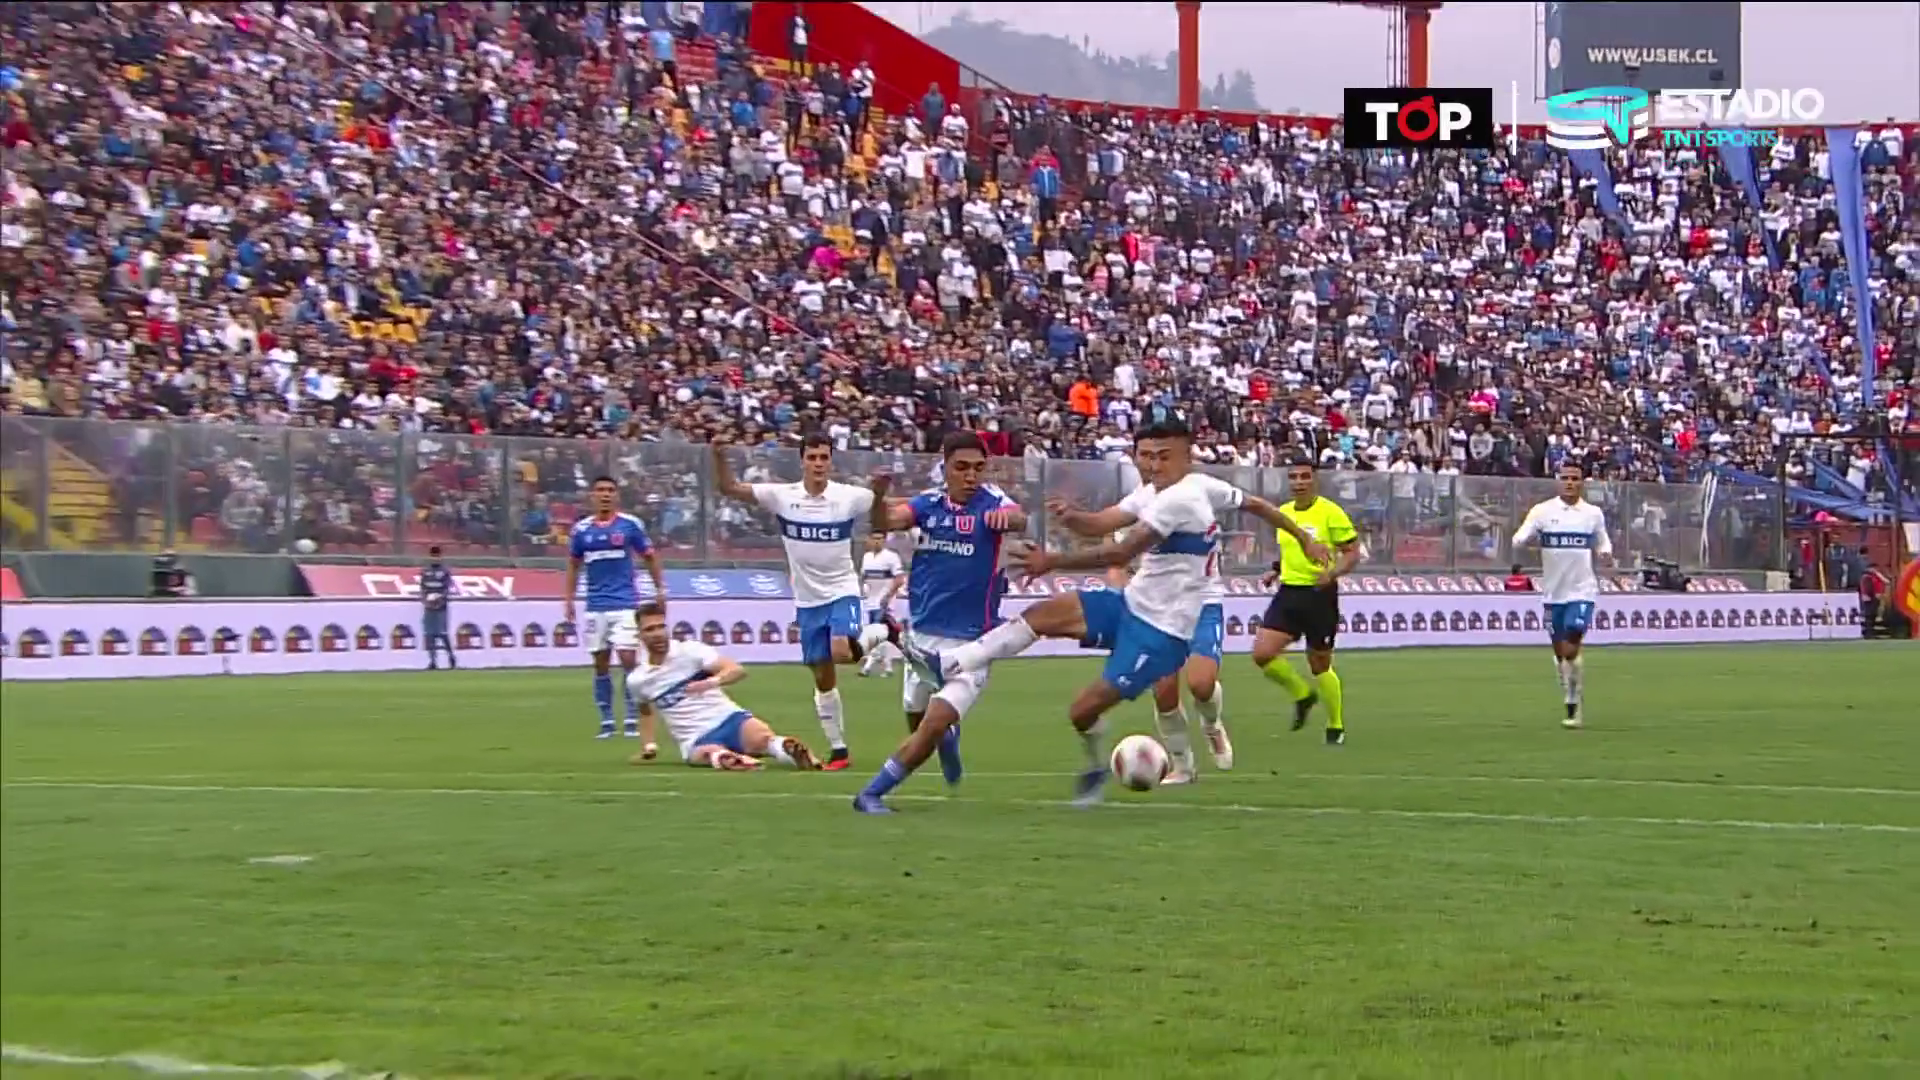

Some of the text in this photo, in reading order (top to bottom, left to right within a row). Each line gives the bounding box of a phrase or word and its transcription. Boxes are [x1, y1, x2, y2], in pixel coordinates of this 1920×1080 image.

[1587, 47, 1718, 64] WWW.USEK.CL
[800, 527, 840, 539] BICE
[360, 573, 517, 600] CHRY
